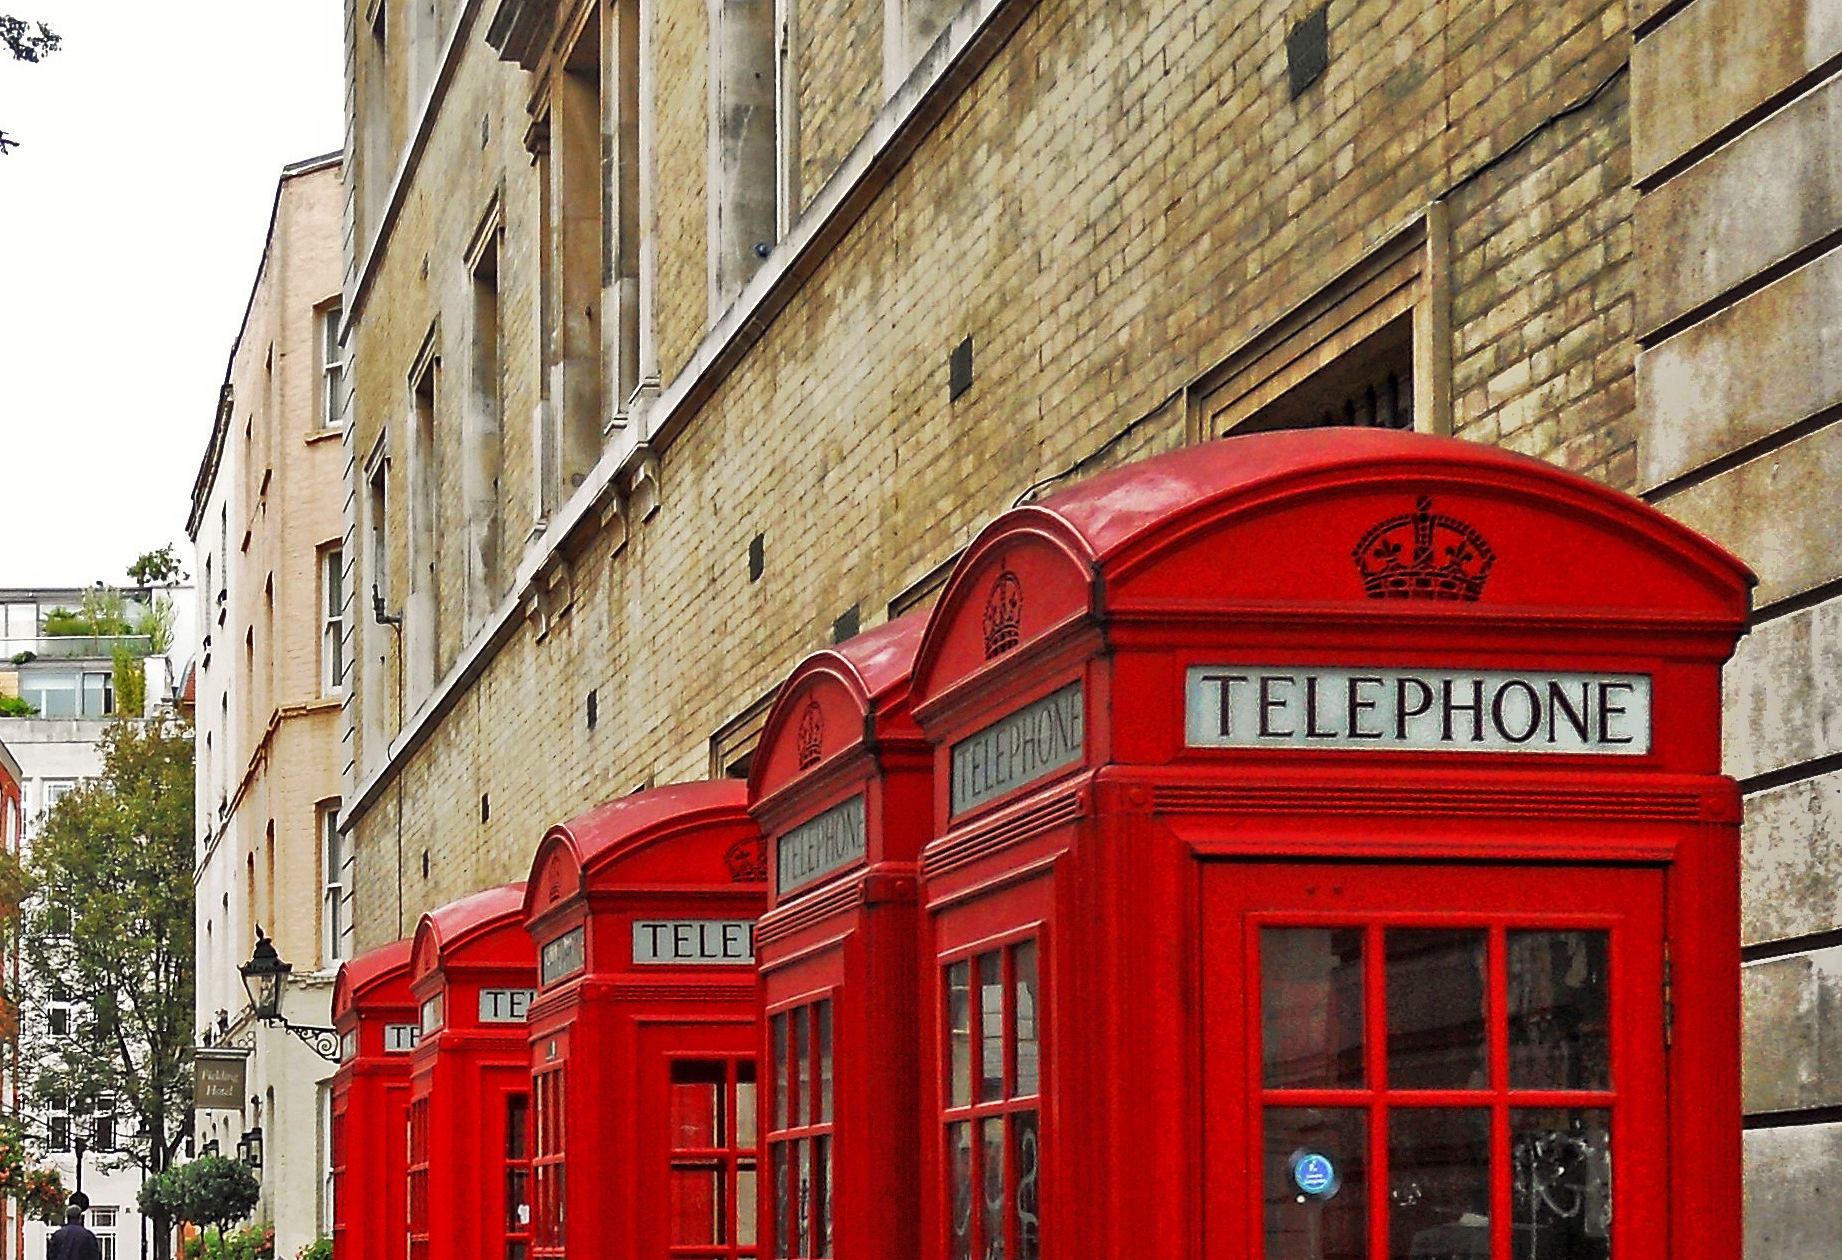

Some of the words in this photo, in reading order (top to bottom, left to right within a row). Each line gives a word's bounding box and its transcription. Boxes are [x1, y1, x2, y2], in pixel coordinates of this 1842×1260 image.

[957, 691, 1082, 804] TELEPHONE
[1200, 674, 1635, 745] TELEPHONE
[781, 796, 865, 884] TELEPHONE
